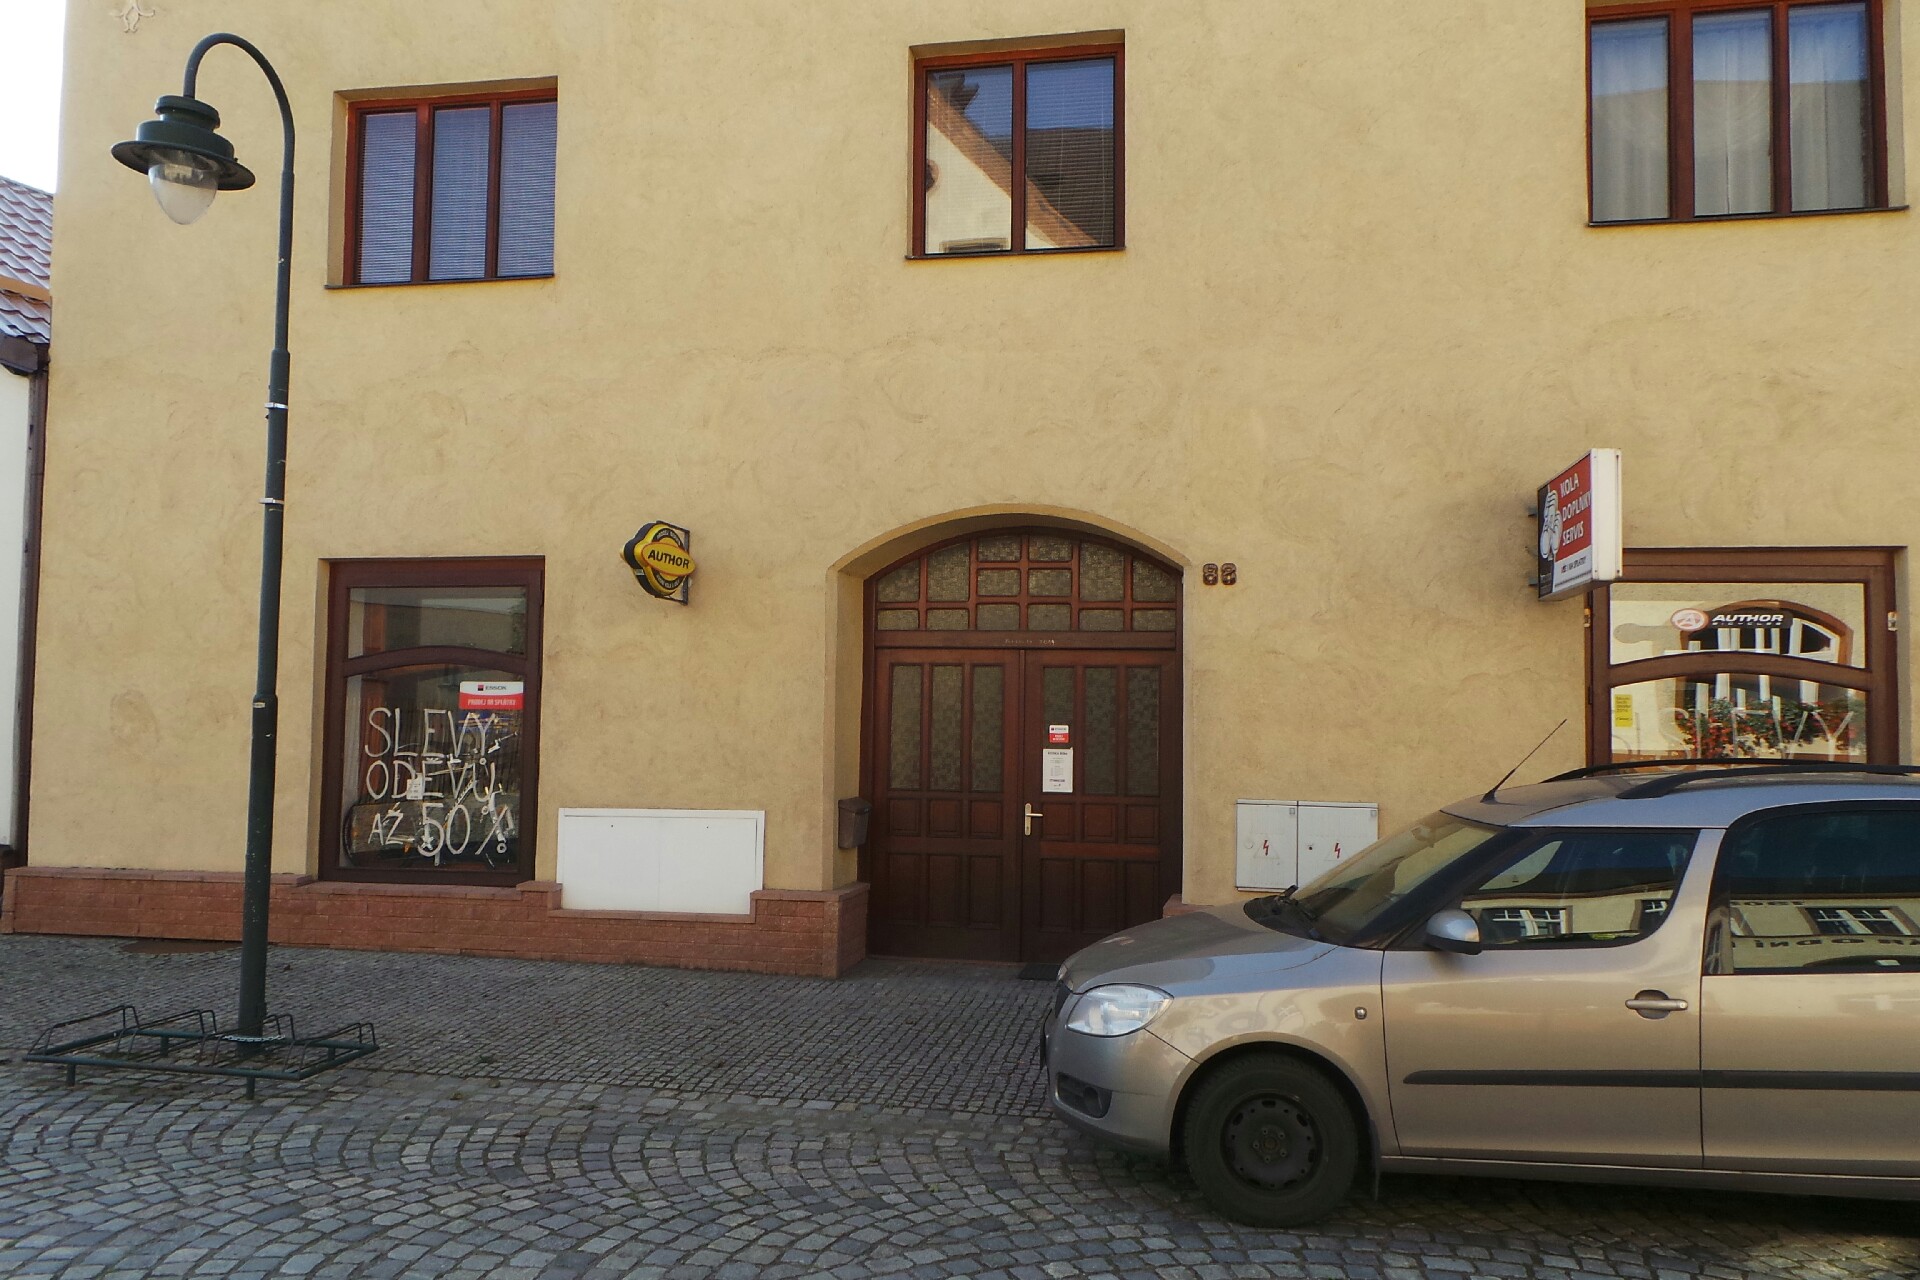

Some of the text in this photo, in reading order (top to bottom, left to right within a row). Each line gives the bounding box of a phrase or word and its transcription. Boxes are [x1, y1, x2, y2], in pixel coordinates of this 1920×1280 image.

[1560, 473, 1579, 498] KOLA
[1563, 521, 1584, 545] SERVIS
[648, 550, 689, 569] AUTHOR
[365, 707, 496, 758] SLEVY
